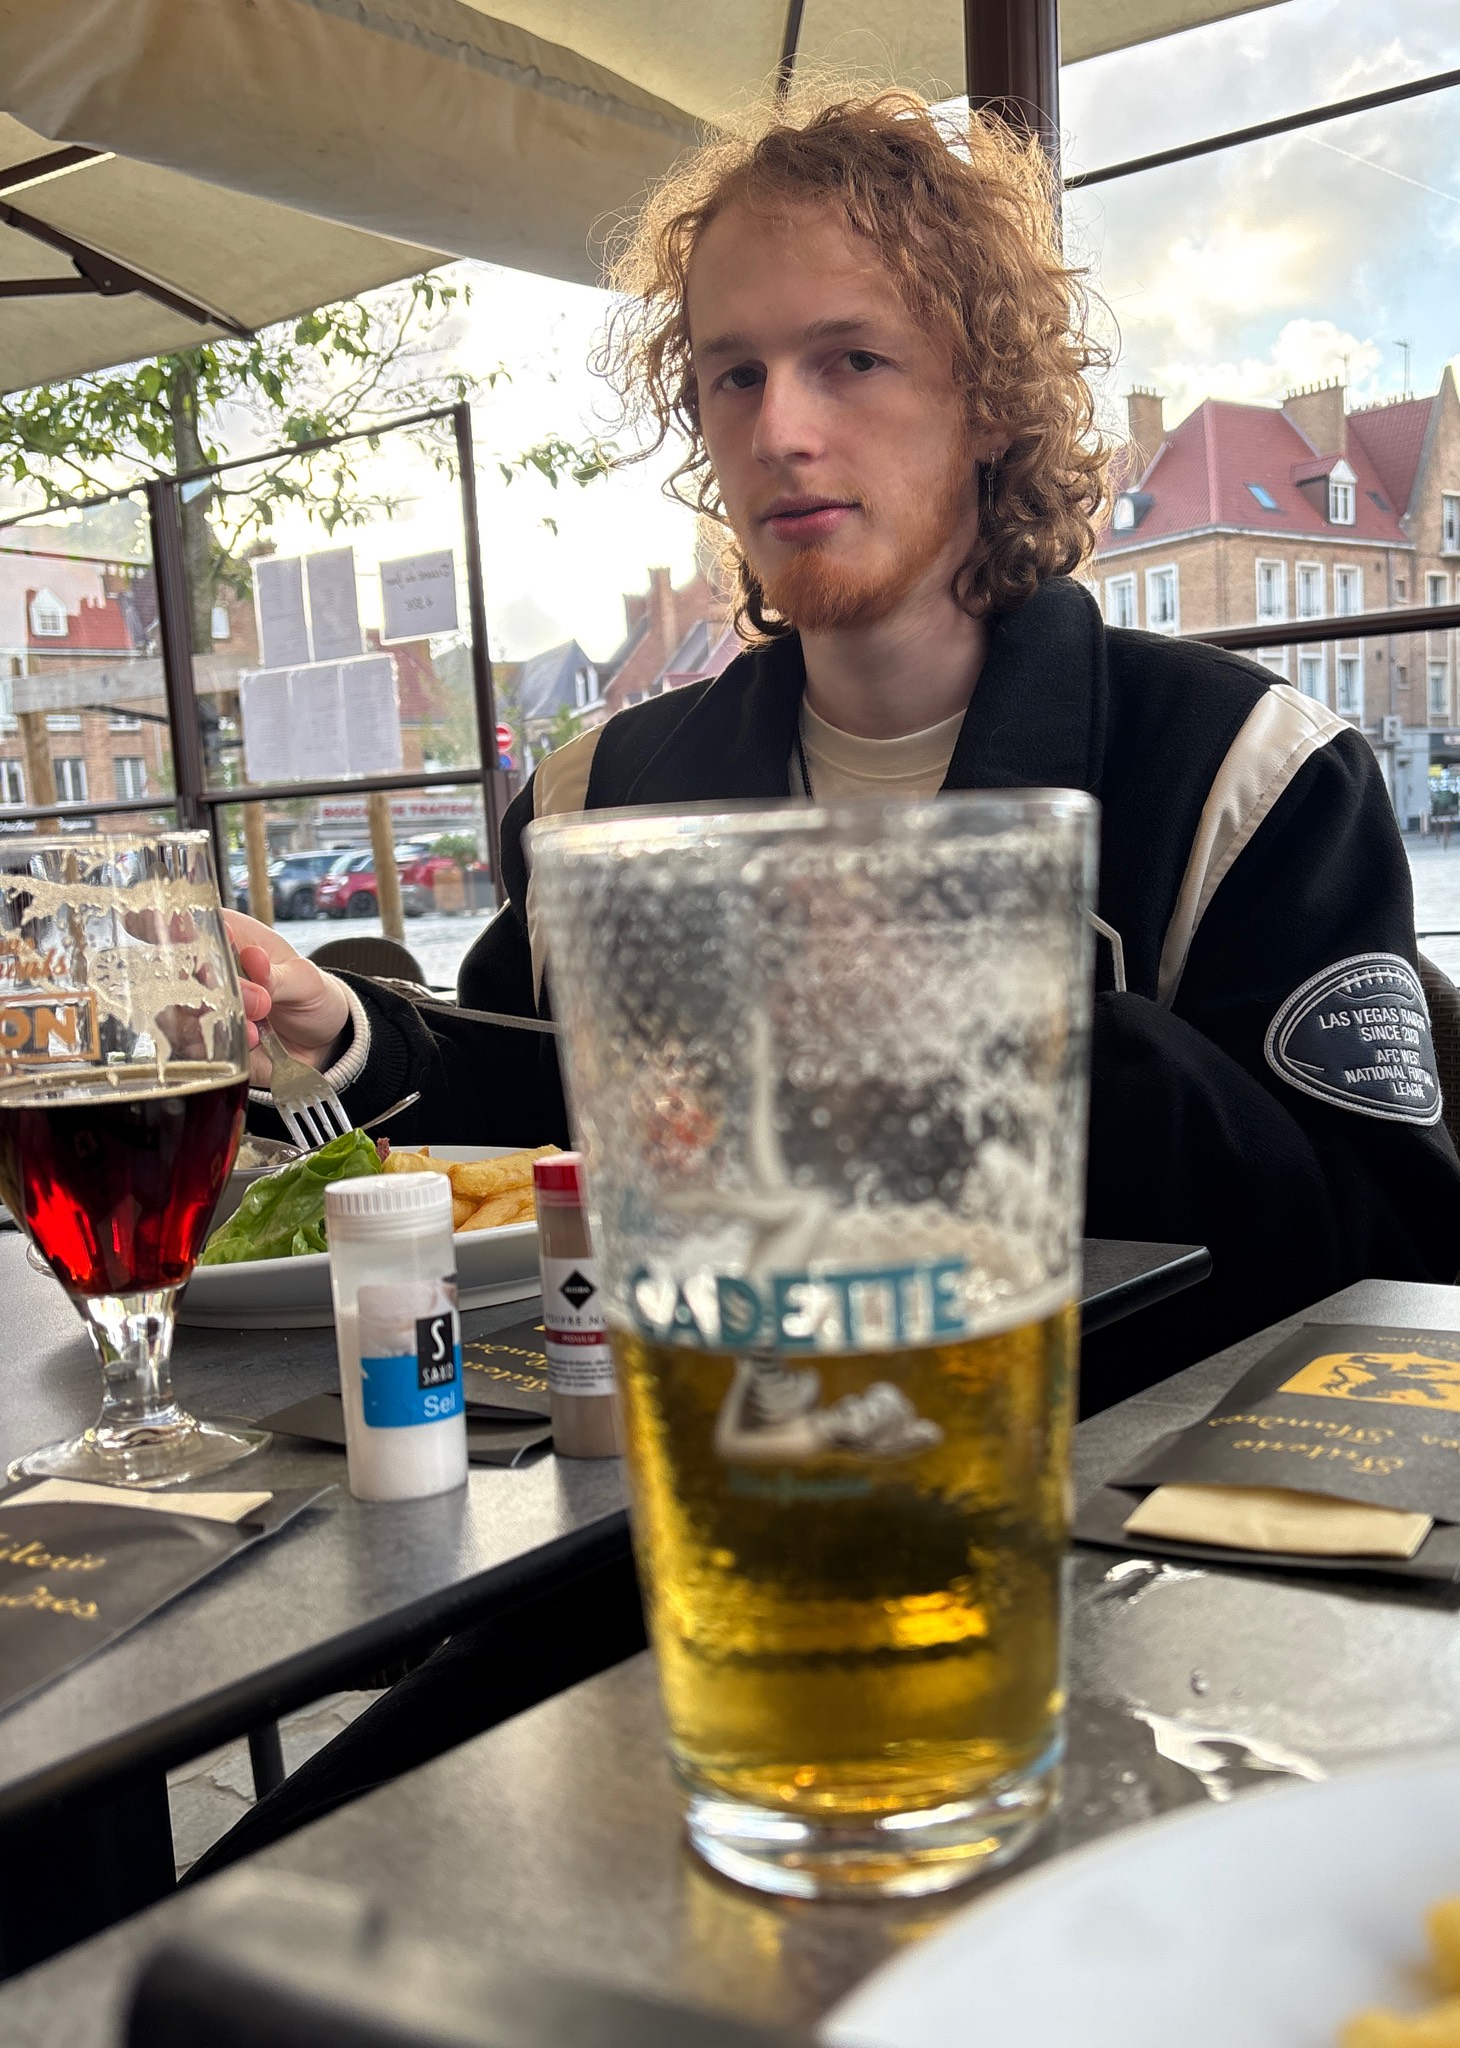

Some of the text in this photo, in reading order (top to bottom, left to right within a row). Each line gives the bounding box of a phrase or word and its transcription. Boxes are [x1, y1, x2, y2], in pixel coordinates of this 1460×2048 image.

[1319, 1010, 1350, 1030] LAS
[1353, 1008, 1399, 1025] VEGAS
[1361, 1025, 1401, 1042] SINCE
[1376, 1049, 1420, 1066] AFC WEST
[1344, 1065, 1407, 1084] NATIONAL
[1392, 1080, 1426, 1099] LEAGUE
[423, 1389, 456, 1417] Sel
[1208, 1414, 1395, 1445] Flandres
[1232, 1439, 1405, 1476] Friterie
